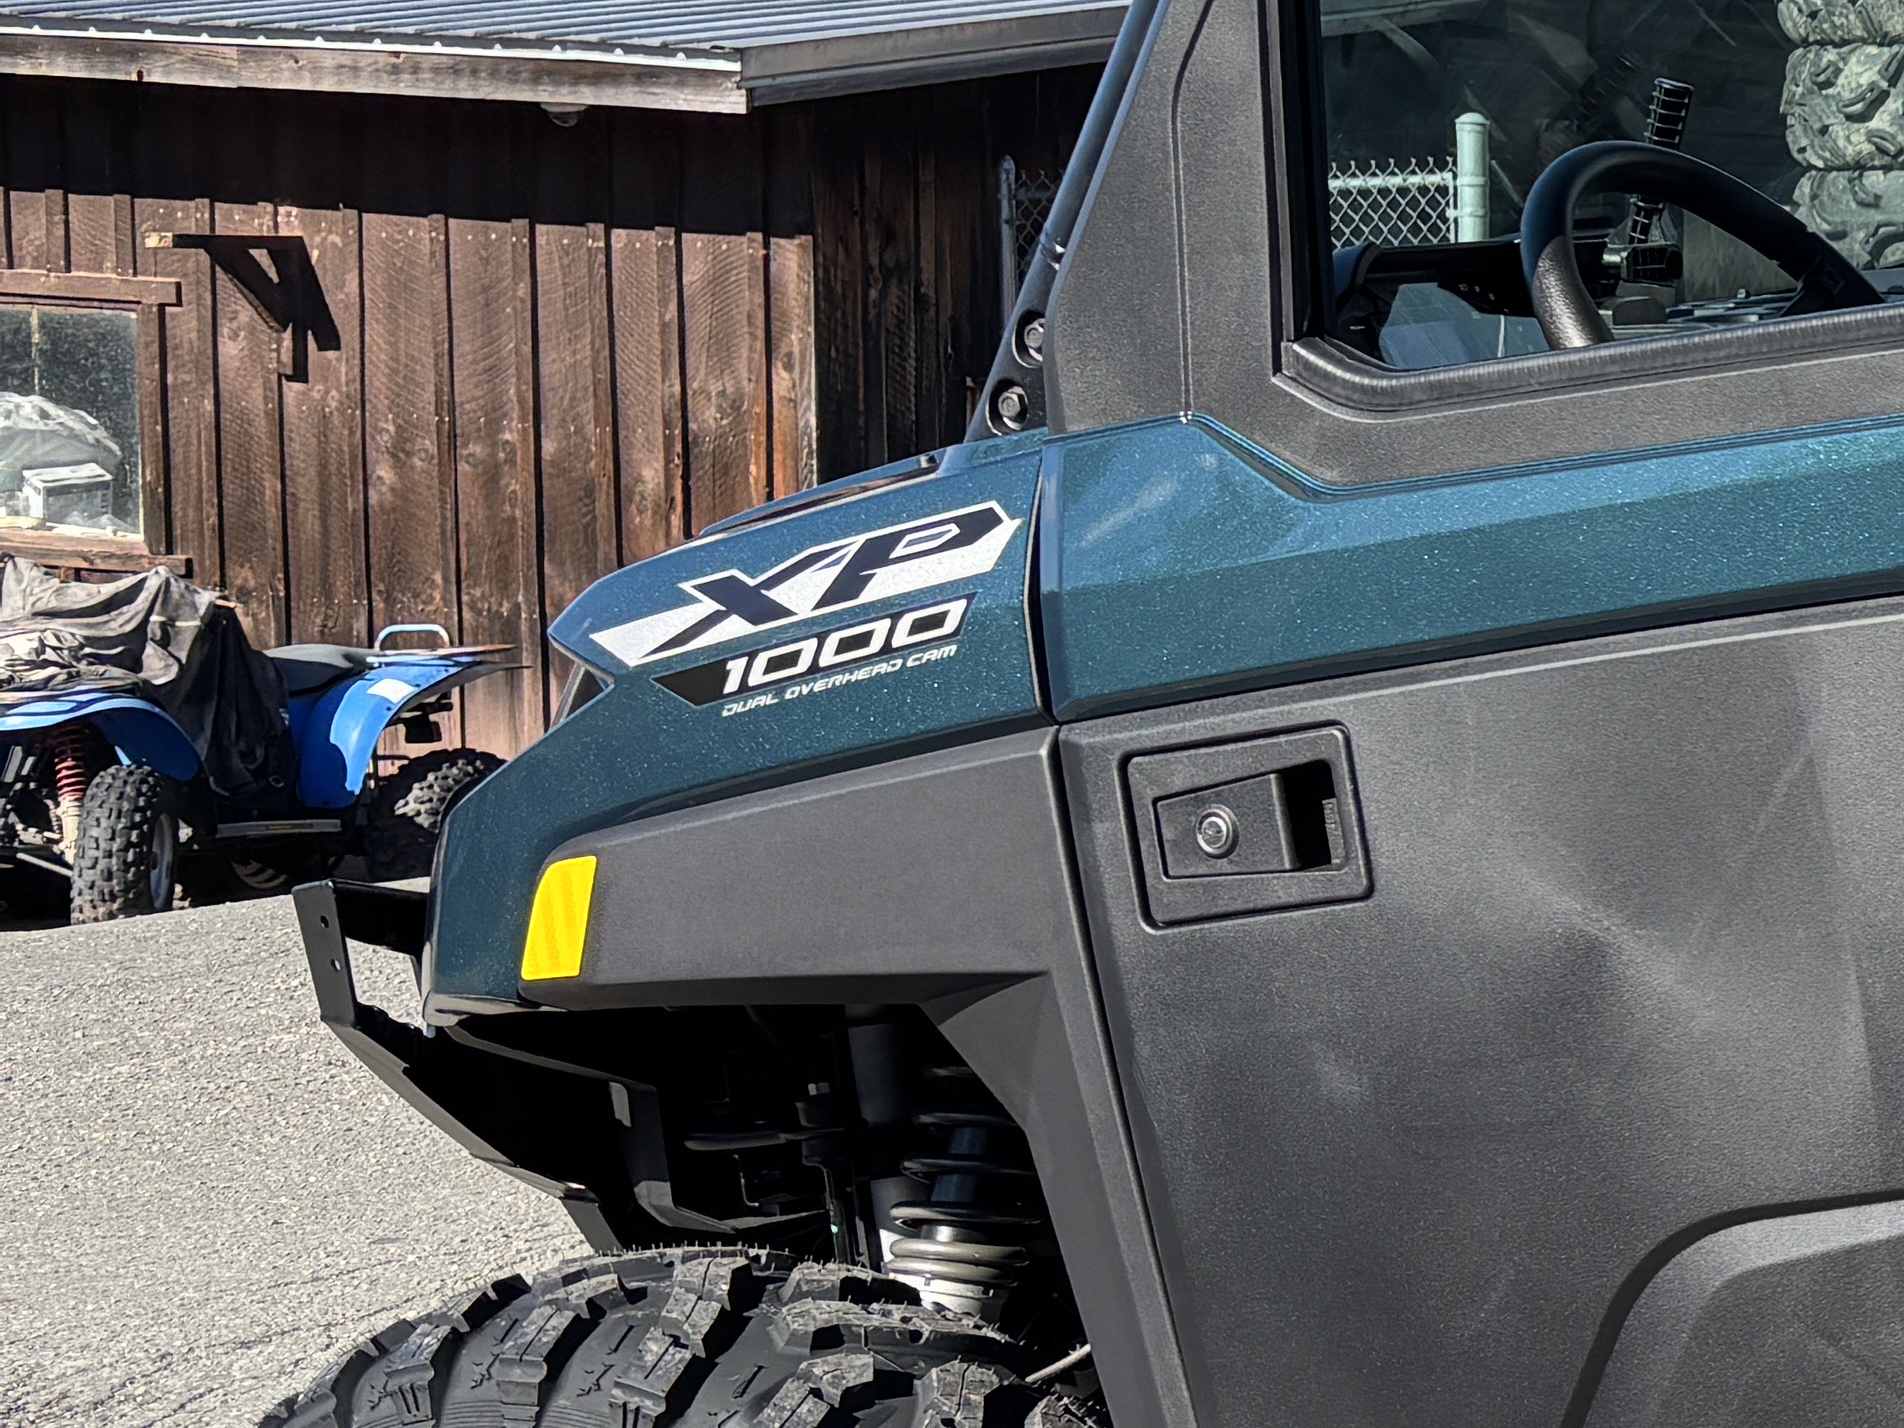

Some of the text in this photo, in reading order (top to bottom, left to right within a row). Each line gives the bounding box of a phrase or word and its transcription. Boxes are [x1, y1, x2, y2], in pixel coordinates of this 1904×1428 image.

[634, 501, 1008, 664] XP
[722, 598, 968, 695] 1000
[722, 644, 958, 718] DUAL OVERHEAD CAM
